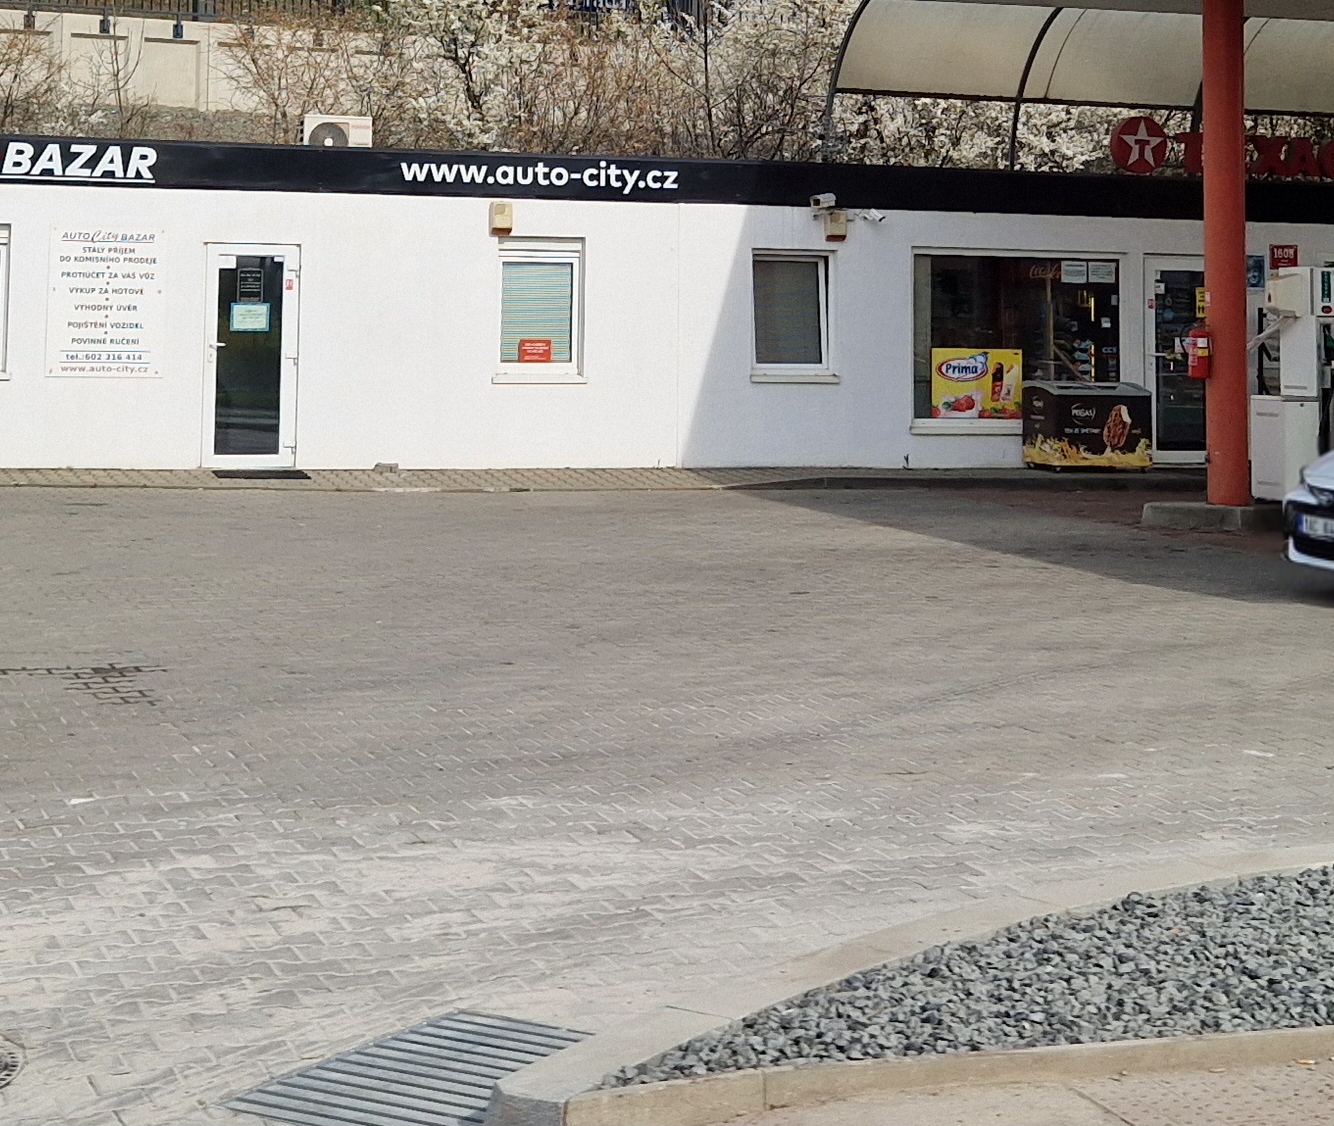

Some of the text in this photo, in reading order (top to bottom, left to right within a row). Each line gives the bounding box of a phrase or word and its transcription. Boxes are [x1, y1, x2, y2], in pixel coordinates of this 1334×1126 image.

[2, 141, 157, 179] BAZAR
[400, 160, 679, 195] www.auto-city.cz
[62, 230, 156, 243] AUTO City BAZAR
[60, 365, 149, 374] www.auto-city.cz
[945, 362, 978, 375] Prima
